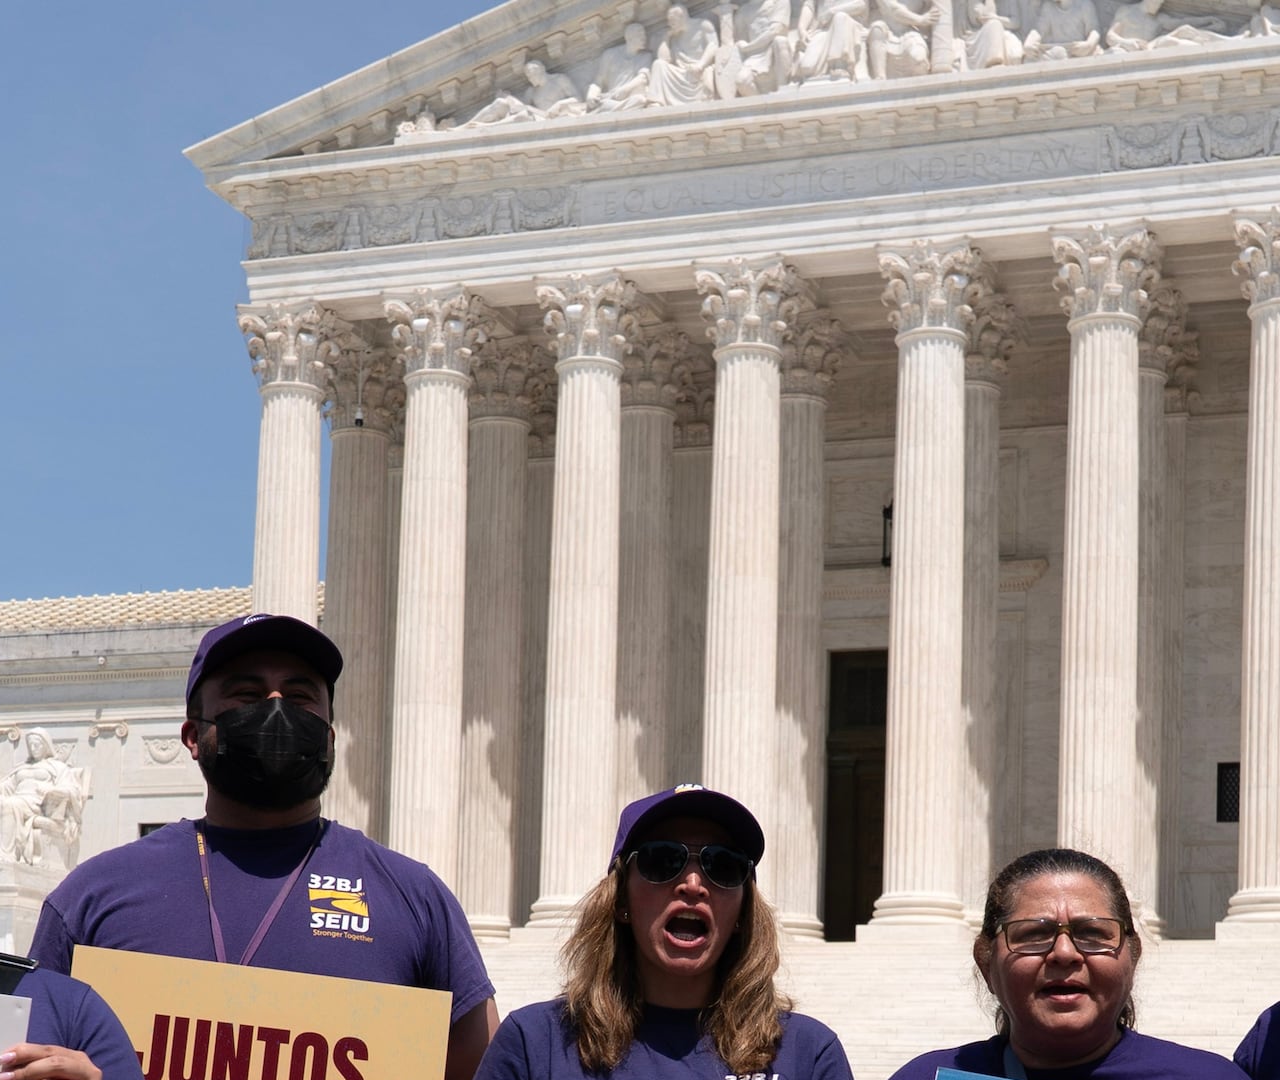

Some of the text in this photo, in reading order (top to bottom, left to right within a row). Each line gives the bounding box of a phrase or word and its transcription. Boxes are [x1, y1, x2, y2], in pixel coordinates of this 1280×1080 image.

[604, 144, 1077, 217] EQUAL JUSTICE UNDER LAW
[308, 873, 362, 892] 32BJ
[310, 912, 370, 933] SEIU
[313, 928, 374, 943] Stronger Together
